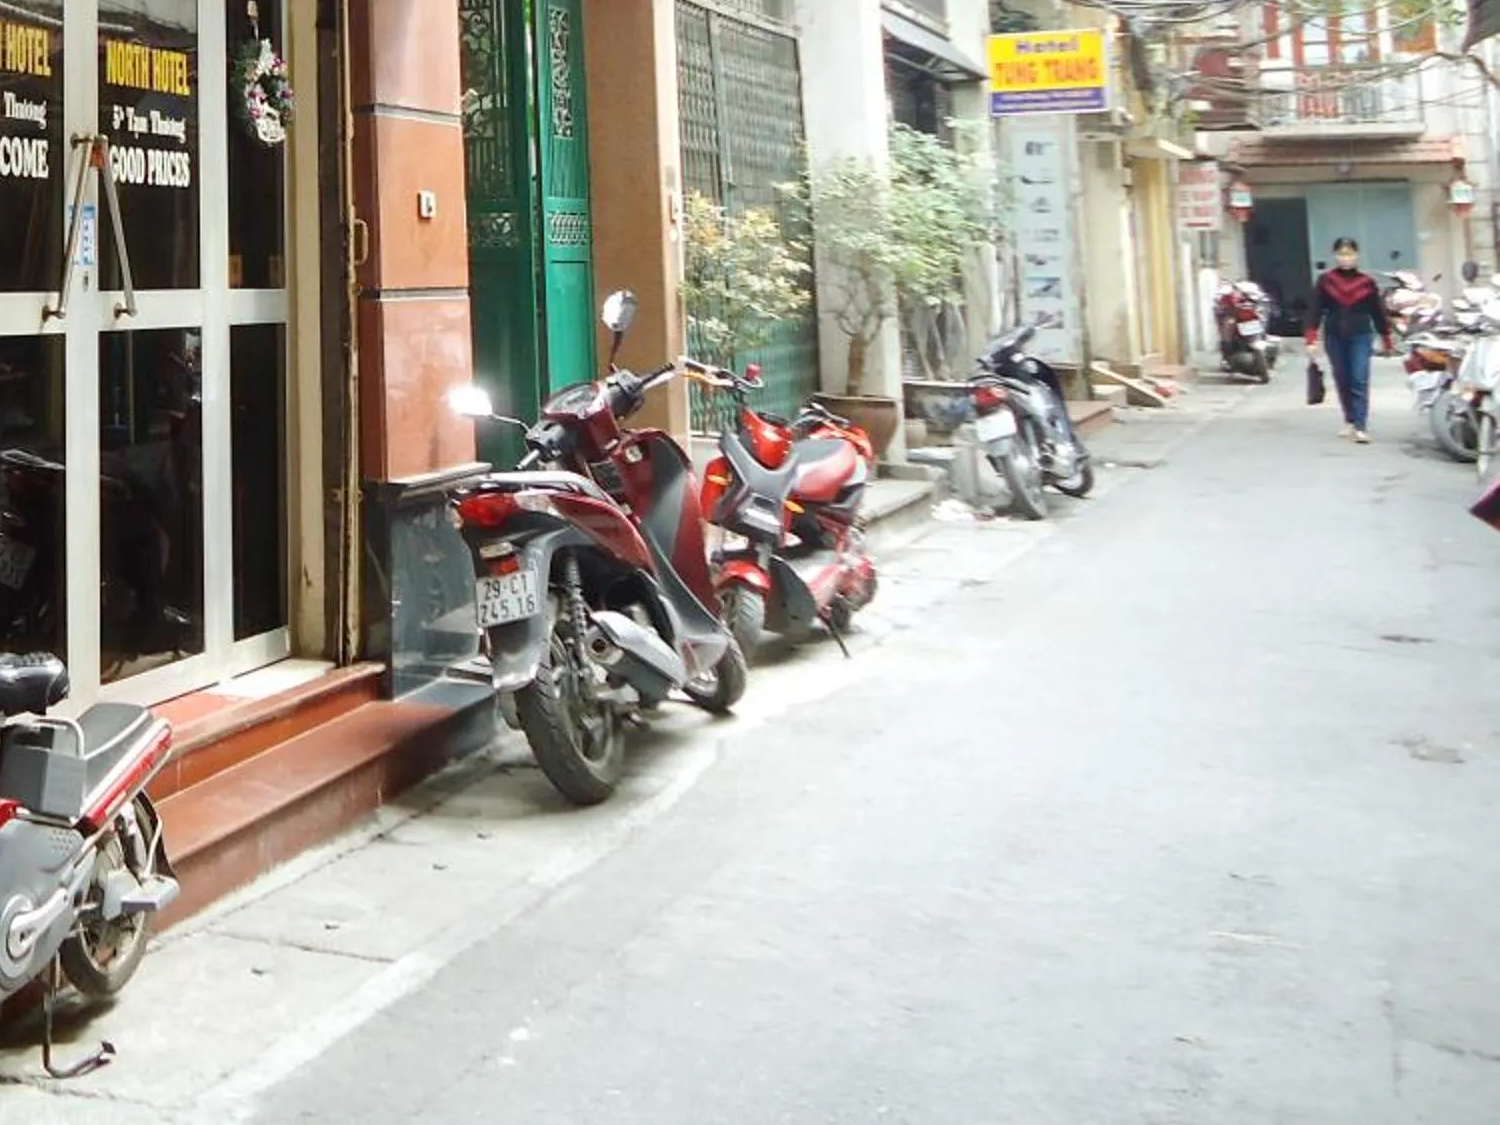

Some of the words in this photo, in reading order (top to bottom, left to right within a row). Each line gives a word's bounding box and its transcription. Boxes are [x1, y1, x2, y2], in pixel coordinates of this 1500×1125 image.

[5, 25, 51, 76] HOTEL
[106, 39, 149, 89] NORTH
[152, 49, 190, 96] HOTEL
[109, 144, 145, 186] GOOD
[148, 147, 190, 188] PRICES
